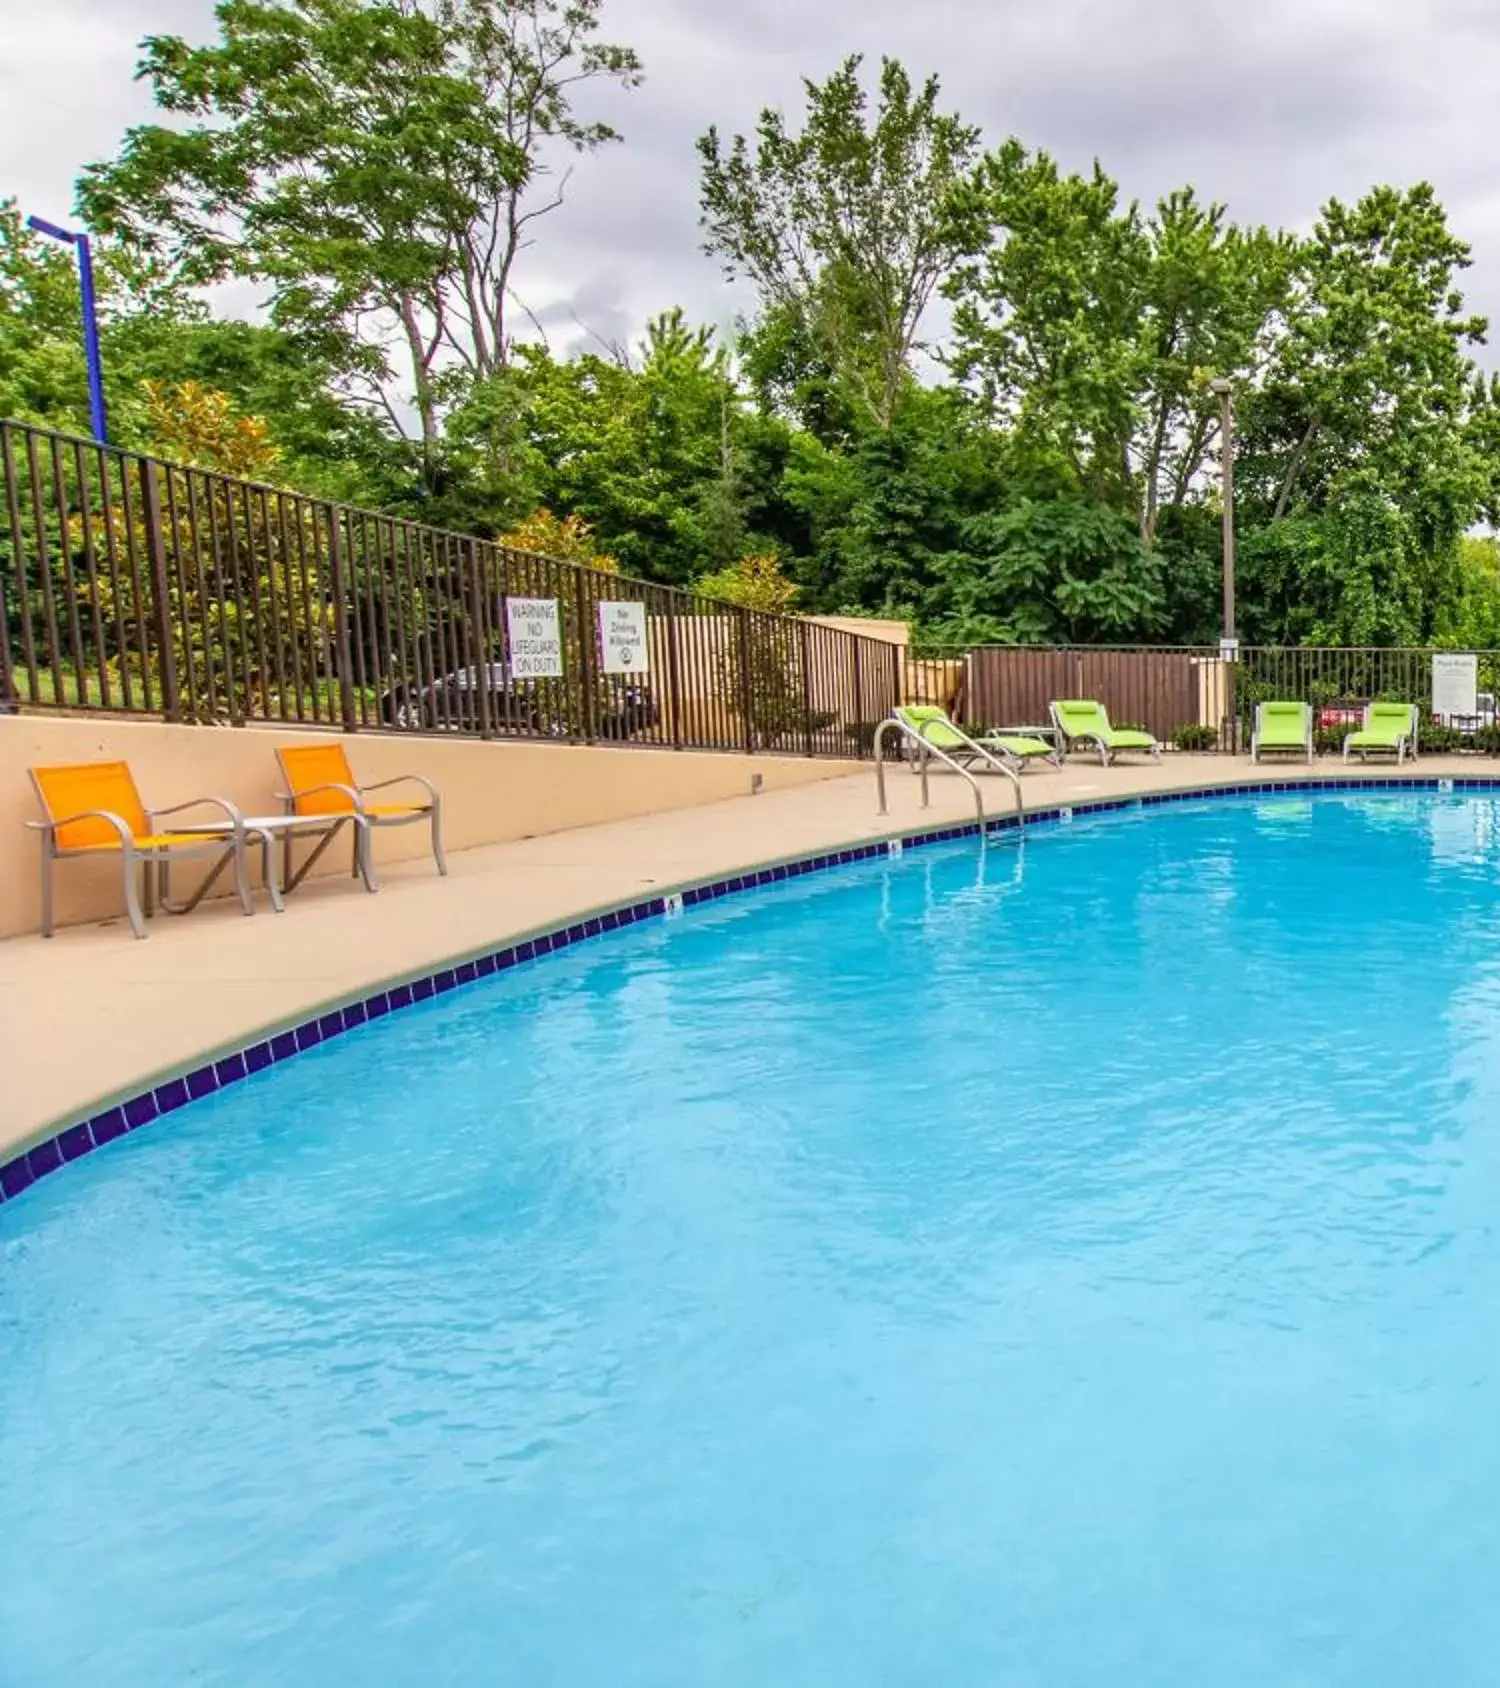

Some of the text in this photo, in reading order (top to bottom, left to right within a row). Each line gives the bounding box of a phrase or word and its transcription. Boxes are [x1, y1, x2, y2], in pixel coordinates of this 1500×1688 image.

[512, 605, 554, 619] WARNING
[617, 609, 628, 618] No
[527, 622, 543, 637] NO
[517, 658, 557, 673] ON DUTY
